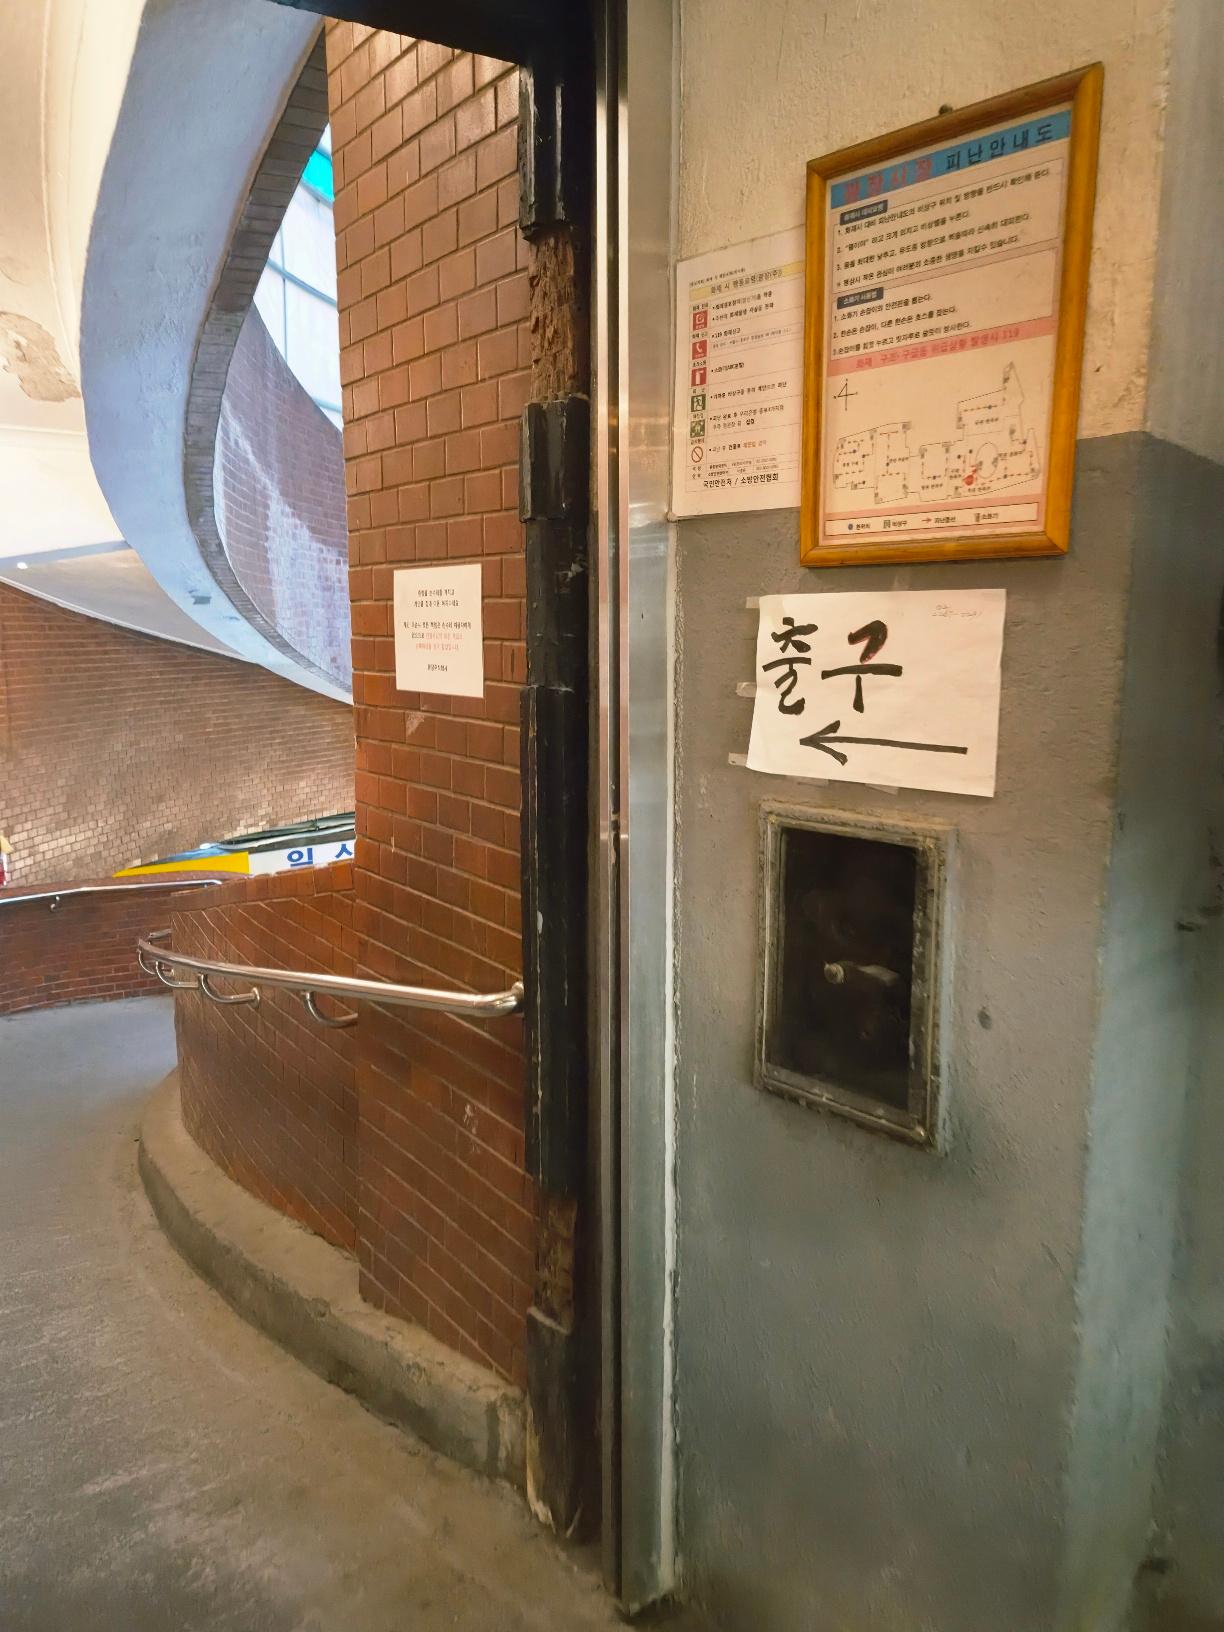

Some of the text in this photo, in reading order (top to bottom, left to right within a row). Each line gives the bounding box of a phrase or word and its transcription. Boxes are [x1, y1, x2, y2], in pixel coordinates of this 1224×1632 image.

[946, 124, 1054, 171] 피난안내도
[880, 319, 892, 329] 다른
[762, 617, 903, 715] 출구
